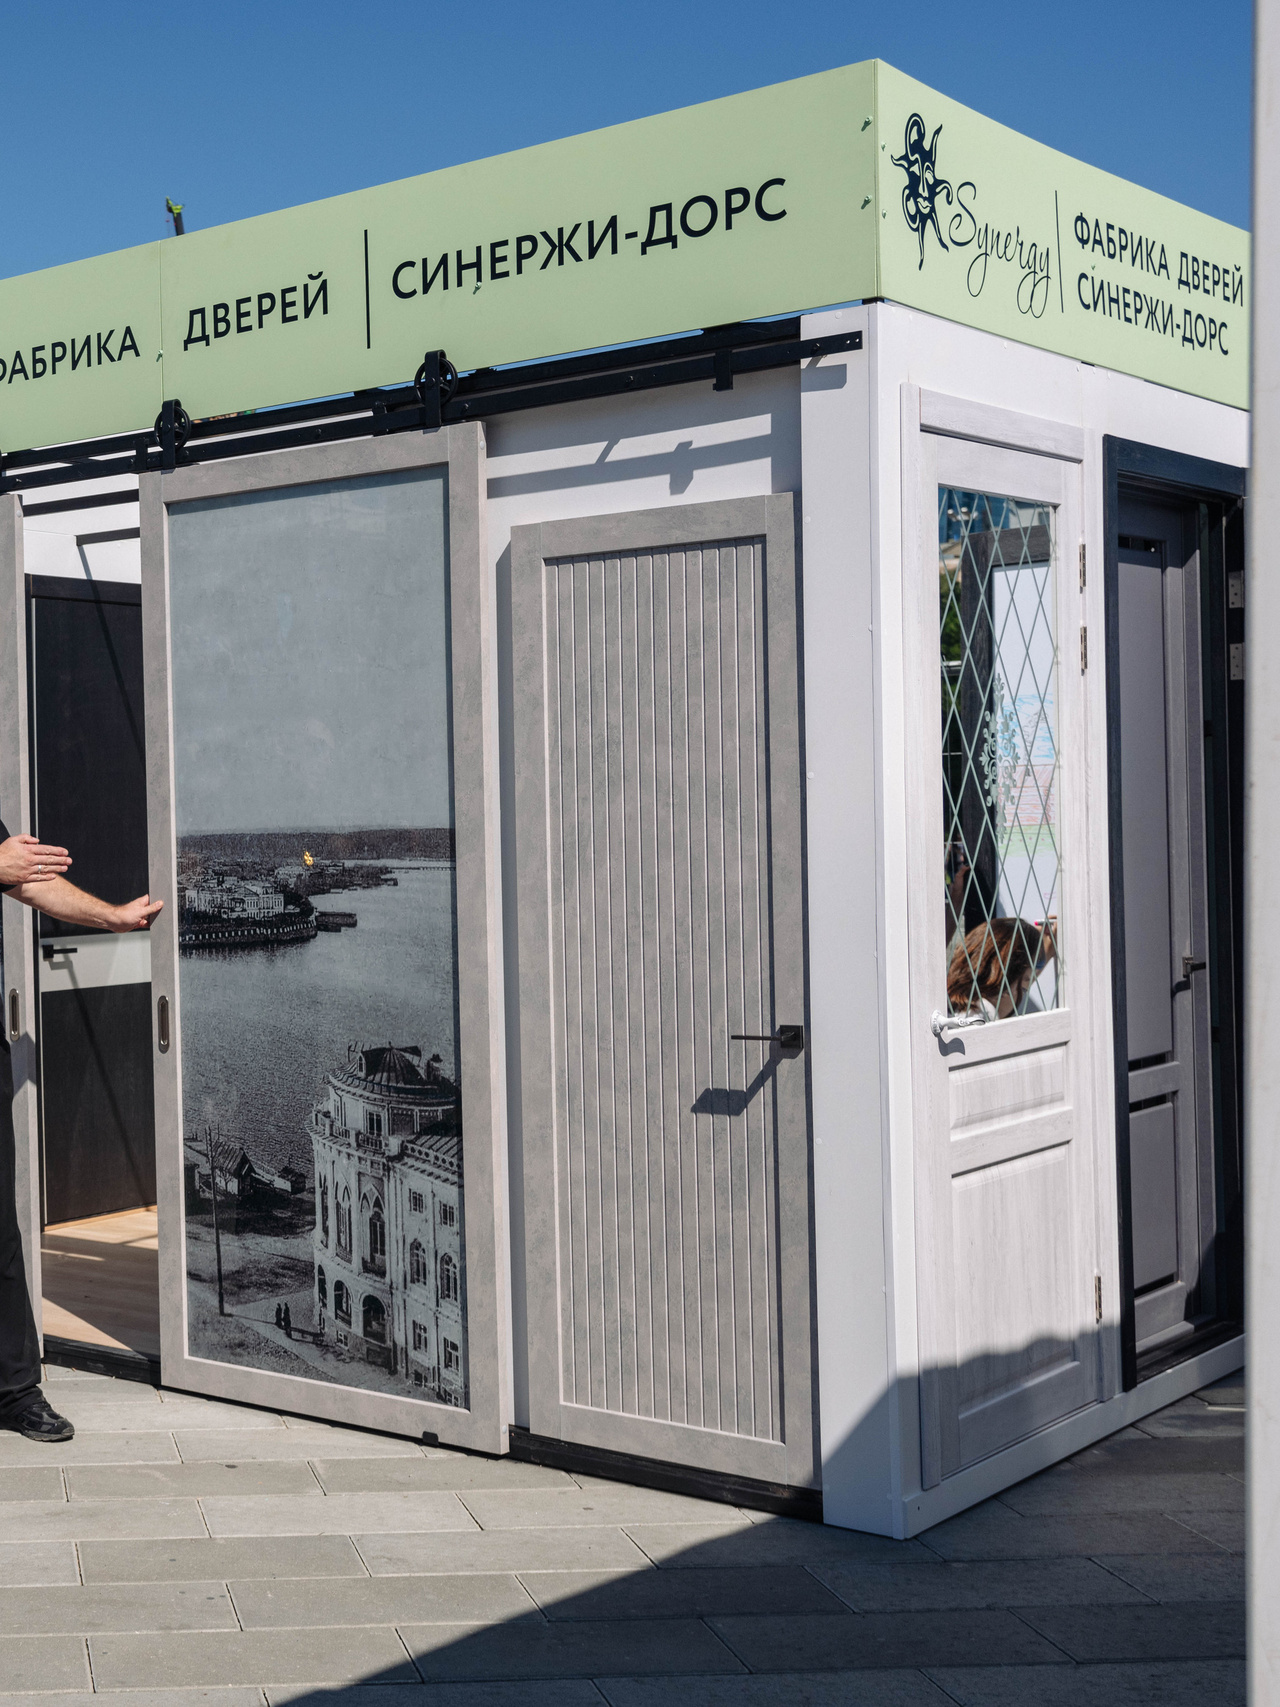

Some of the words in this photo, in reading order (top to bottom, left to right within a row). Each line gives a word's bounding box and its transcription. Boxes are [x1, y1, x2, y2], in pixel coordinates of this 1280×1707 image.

[182, 270, 329, 352] ДВЕРЕЙ
[391, 177, 788, 300] СИНЕРЖИ-ДОРС
[948, 181, 1052, 318] Synergy
[1074, 211, 1170, 280] ФАБРИКА
[1177, 264, 1244, 307] ДВЕРЕЙ
[1077, 272, 1229, 356] СИНЕРЖИ-ДОРС
